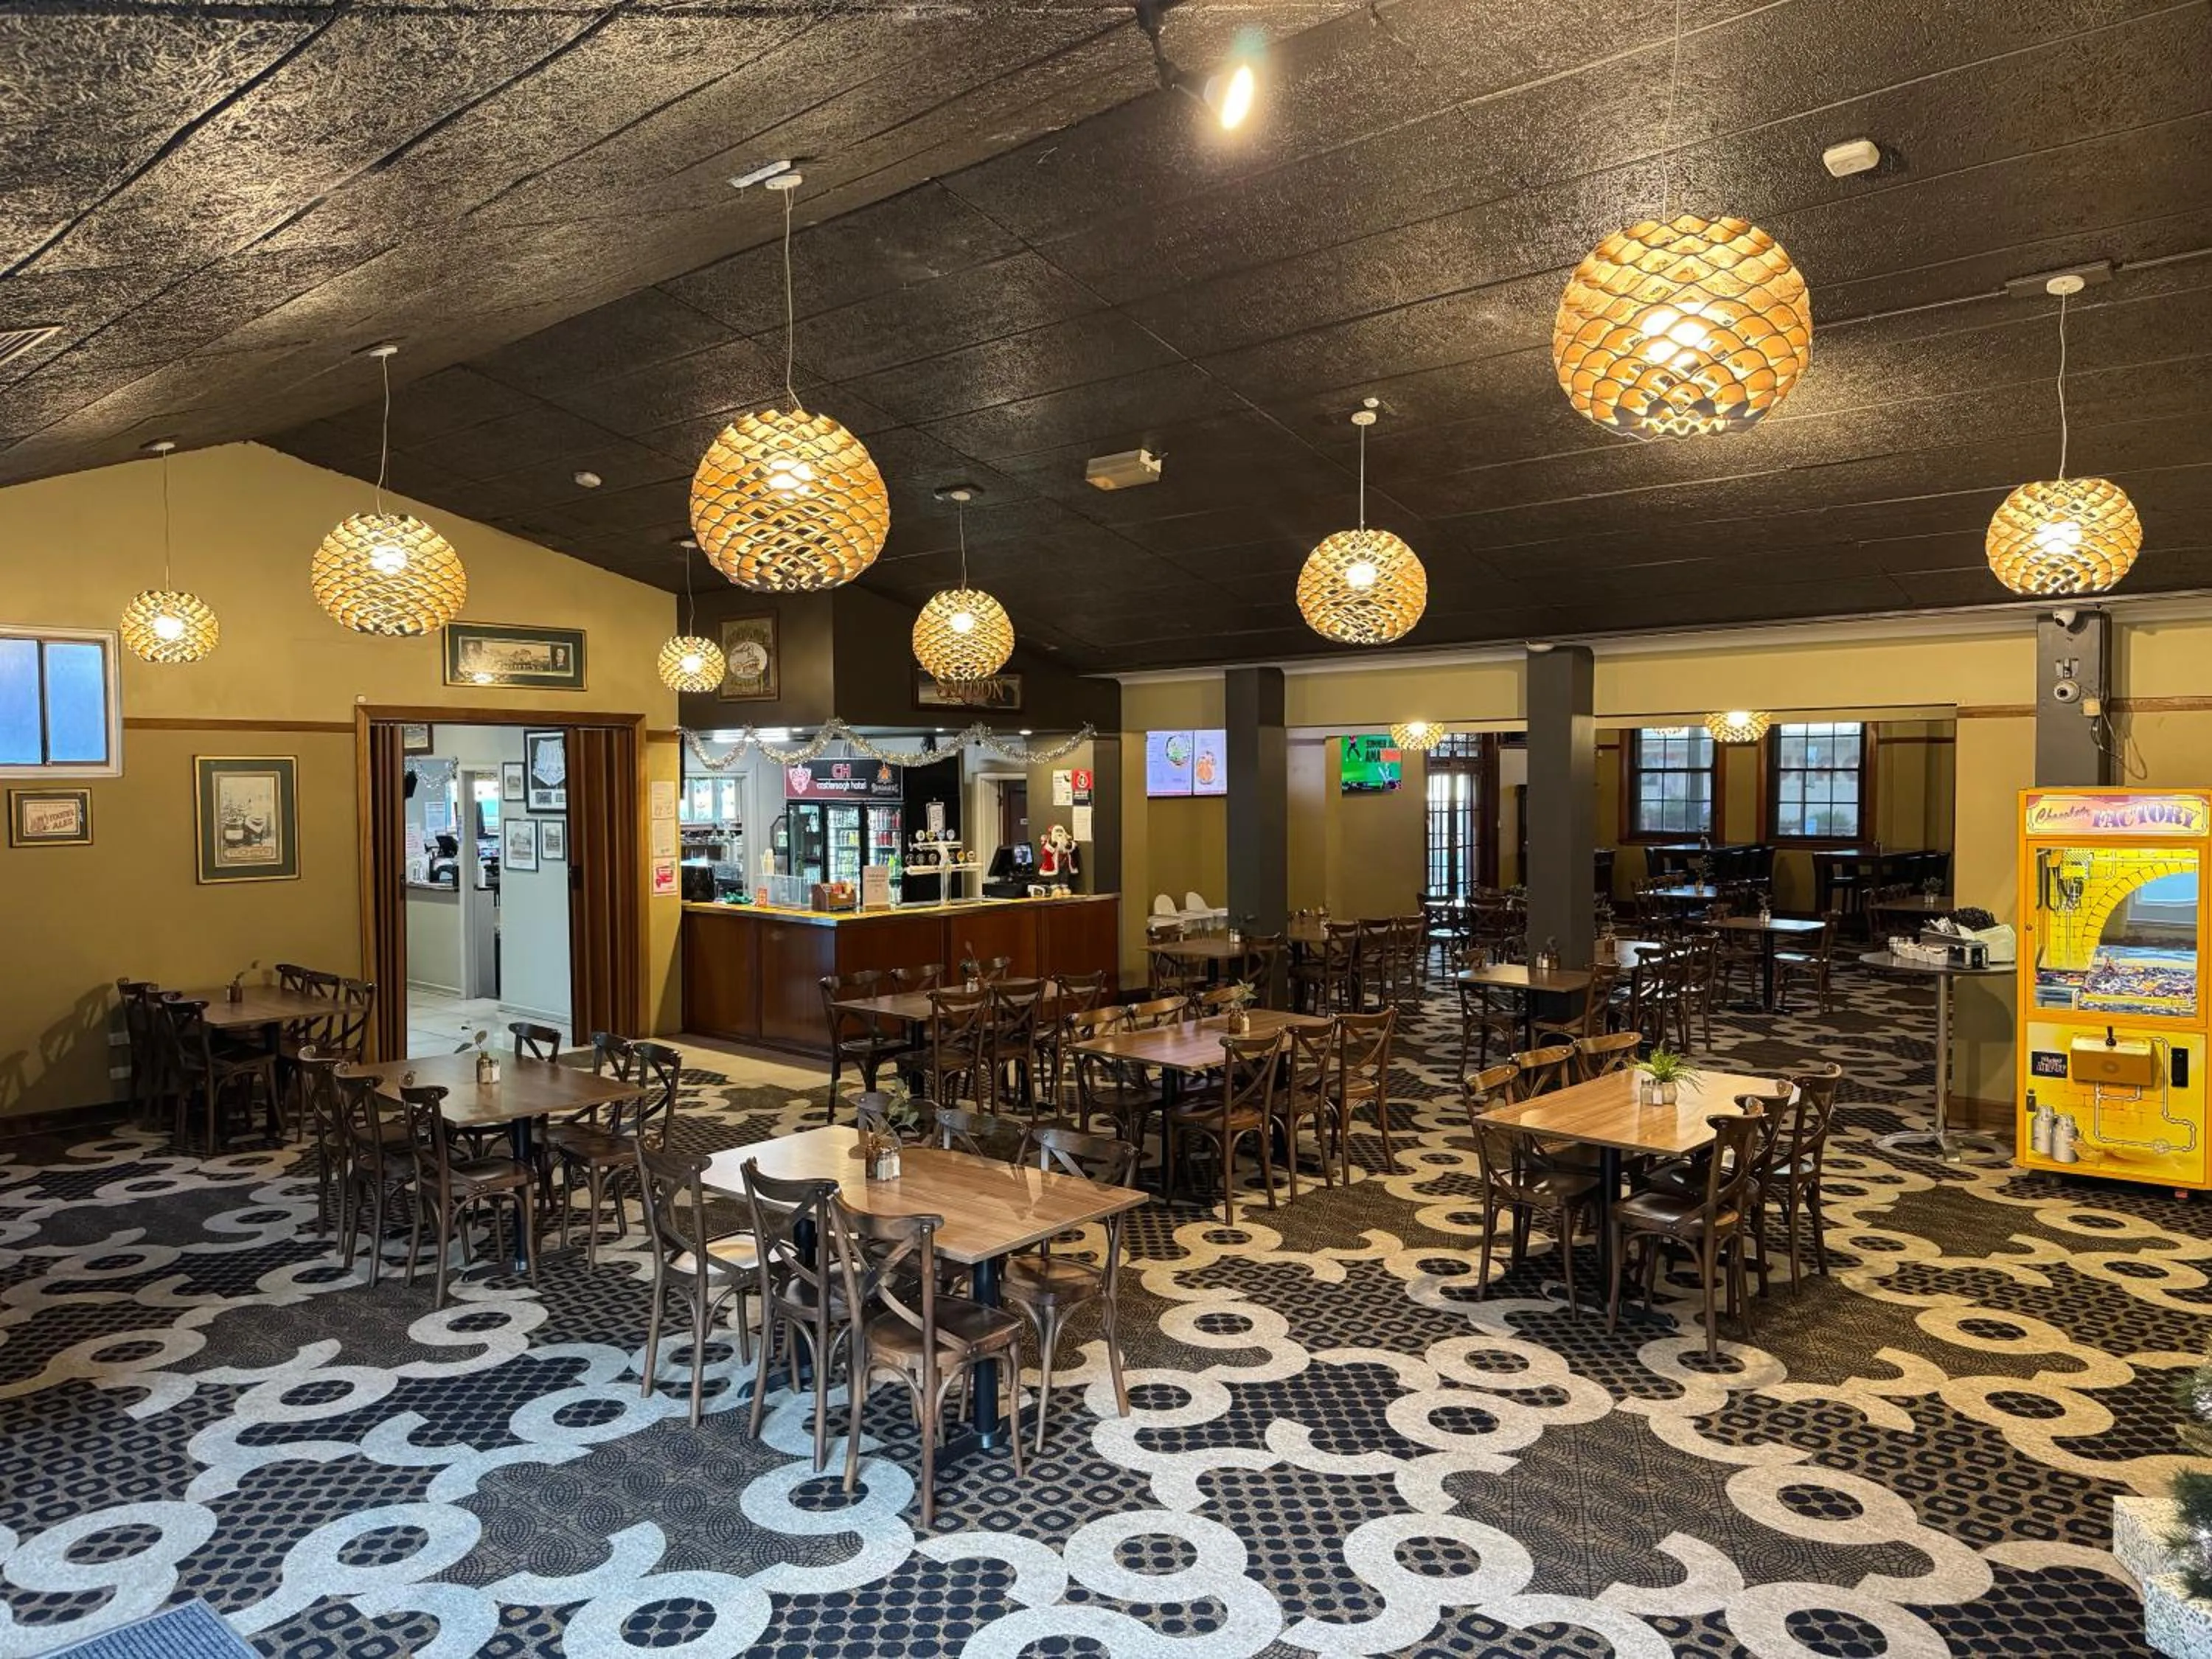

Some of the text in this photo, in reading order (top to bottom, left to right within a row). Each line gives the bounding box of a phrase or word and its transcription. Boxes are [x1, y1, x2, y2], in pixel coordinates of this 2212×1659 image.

[832, 763, 852, 779] CH
[851, 780, 867, 790] hotel
[2091, 802, 2201, 829] FACTORY
